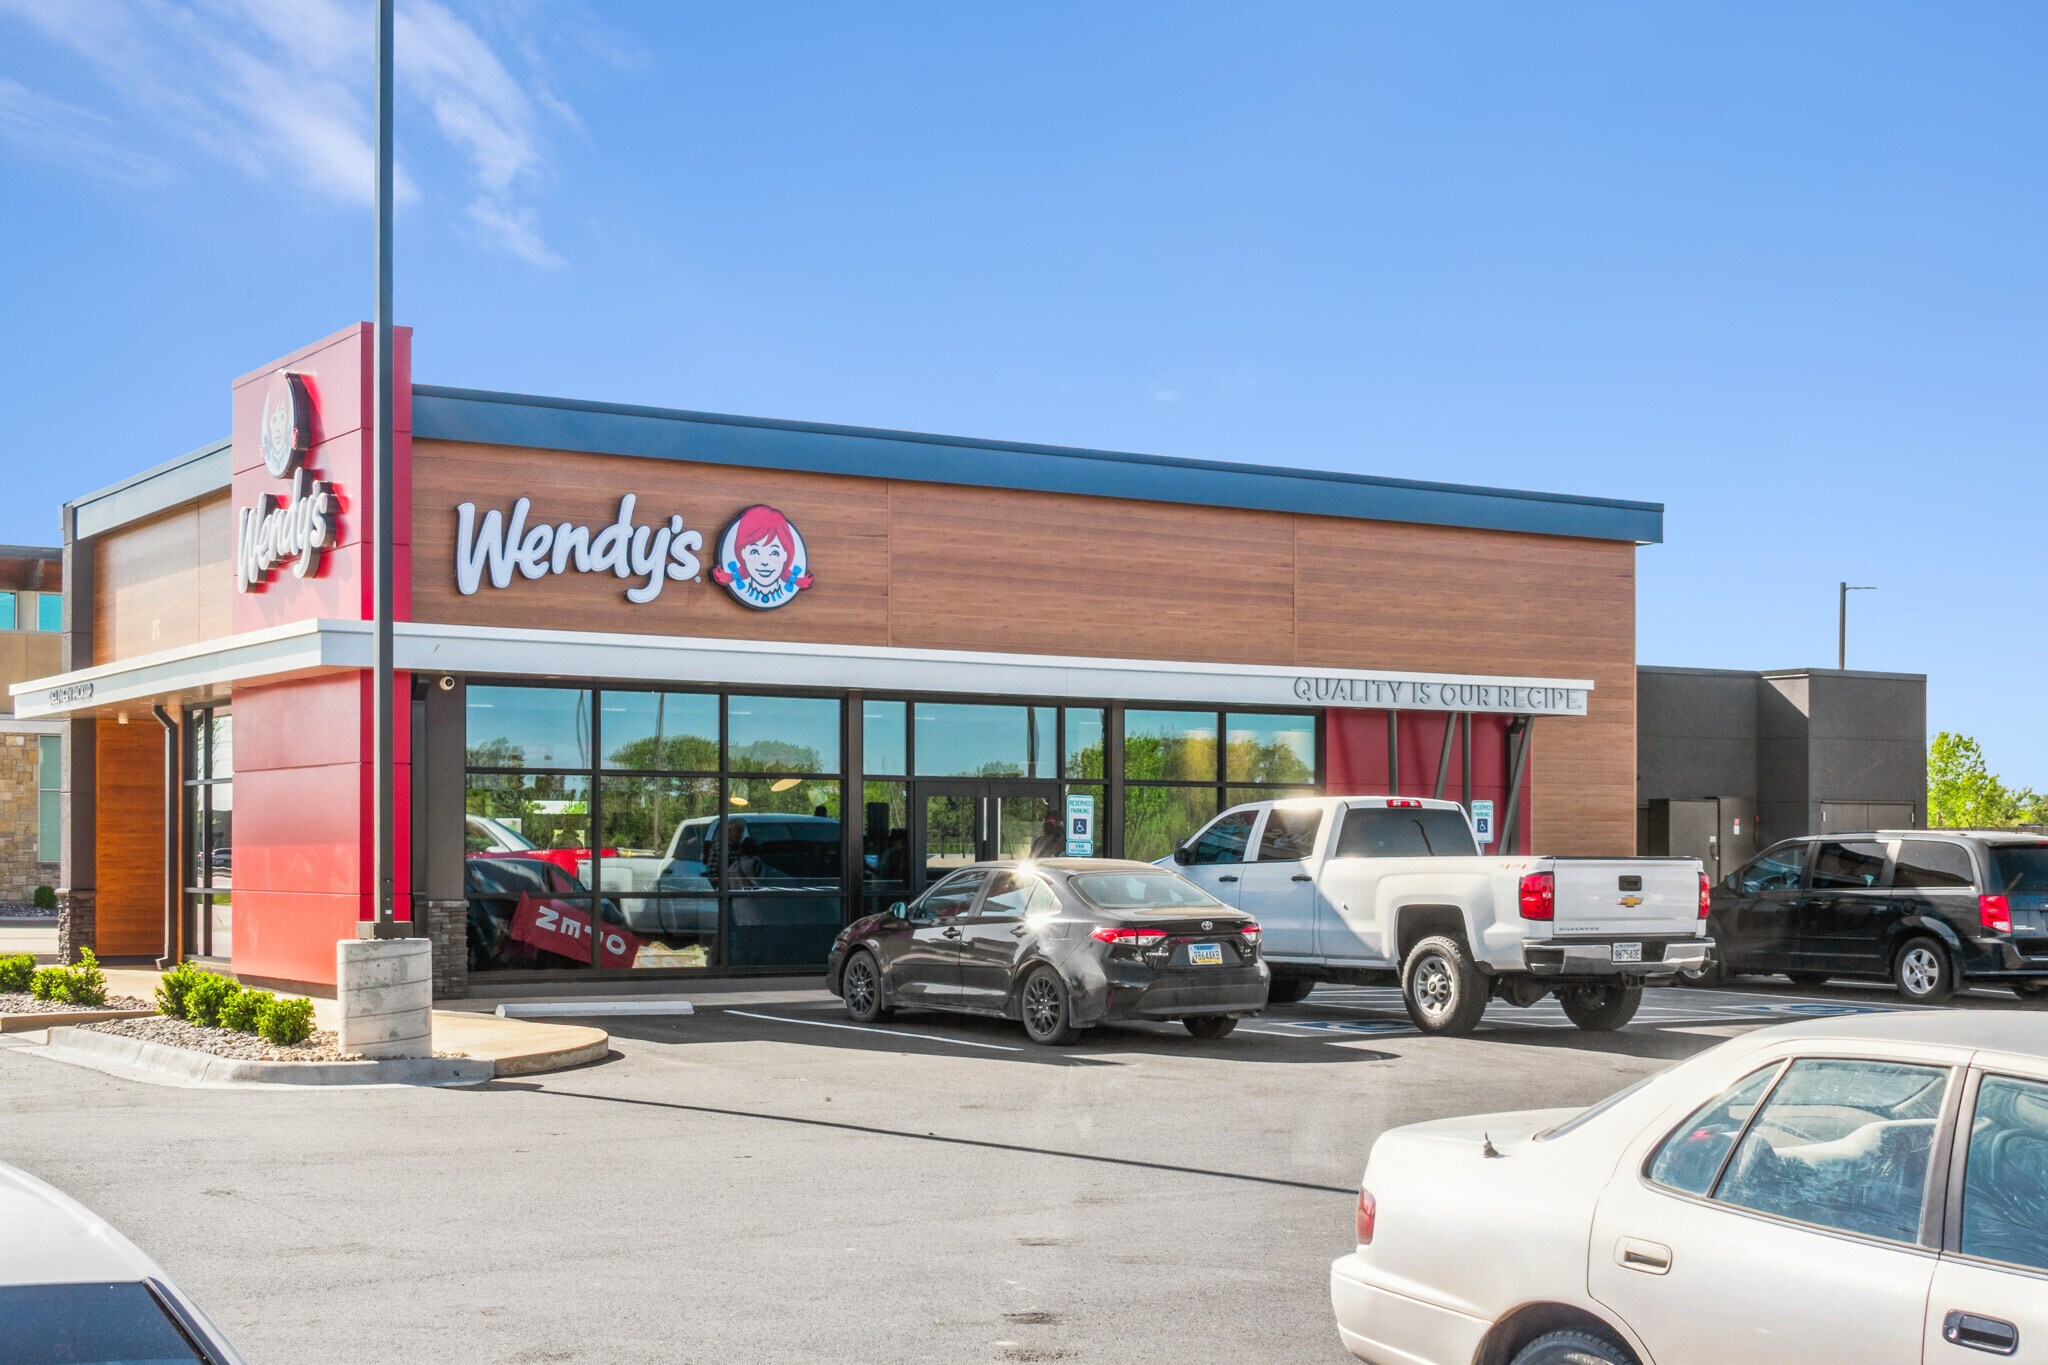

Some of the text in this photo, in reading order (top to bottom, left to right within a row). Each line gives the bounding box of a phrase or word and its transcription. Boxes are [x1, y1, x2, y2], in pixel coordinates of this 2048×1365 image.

[237, 466, 331, 594] Wendy's
[456, 493, 703, 604] Wendy's
[1293, 677, 1583, 710] QUALITY IS OUR RECIPE
